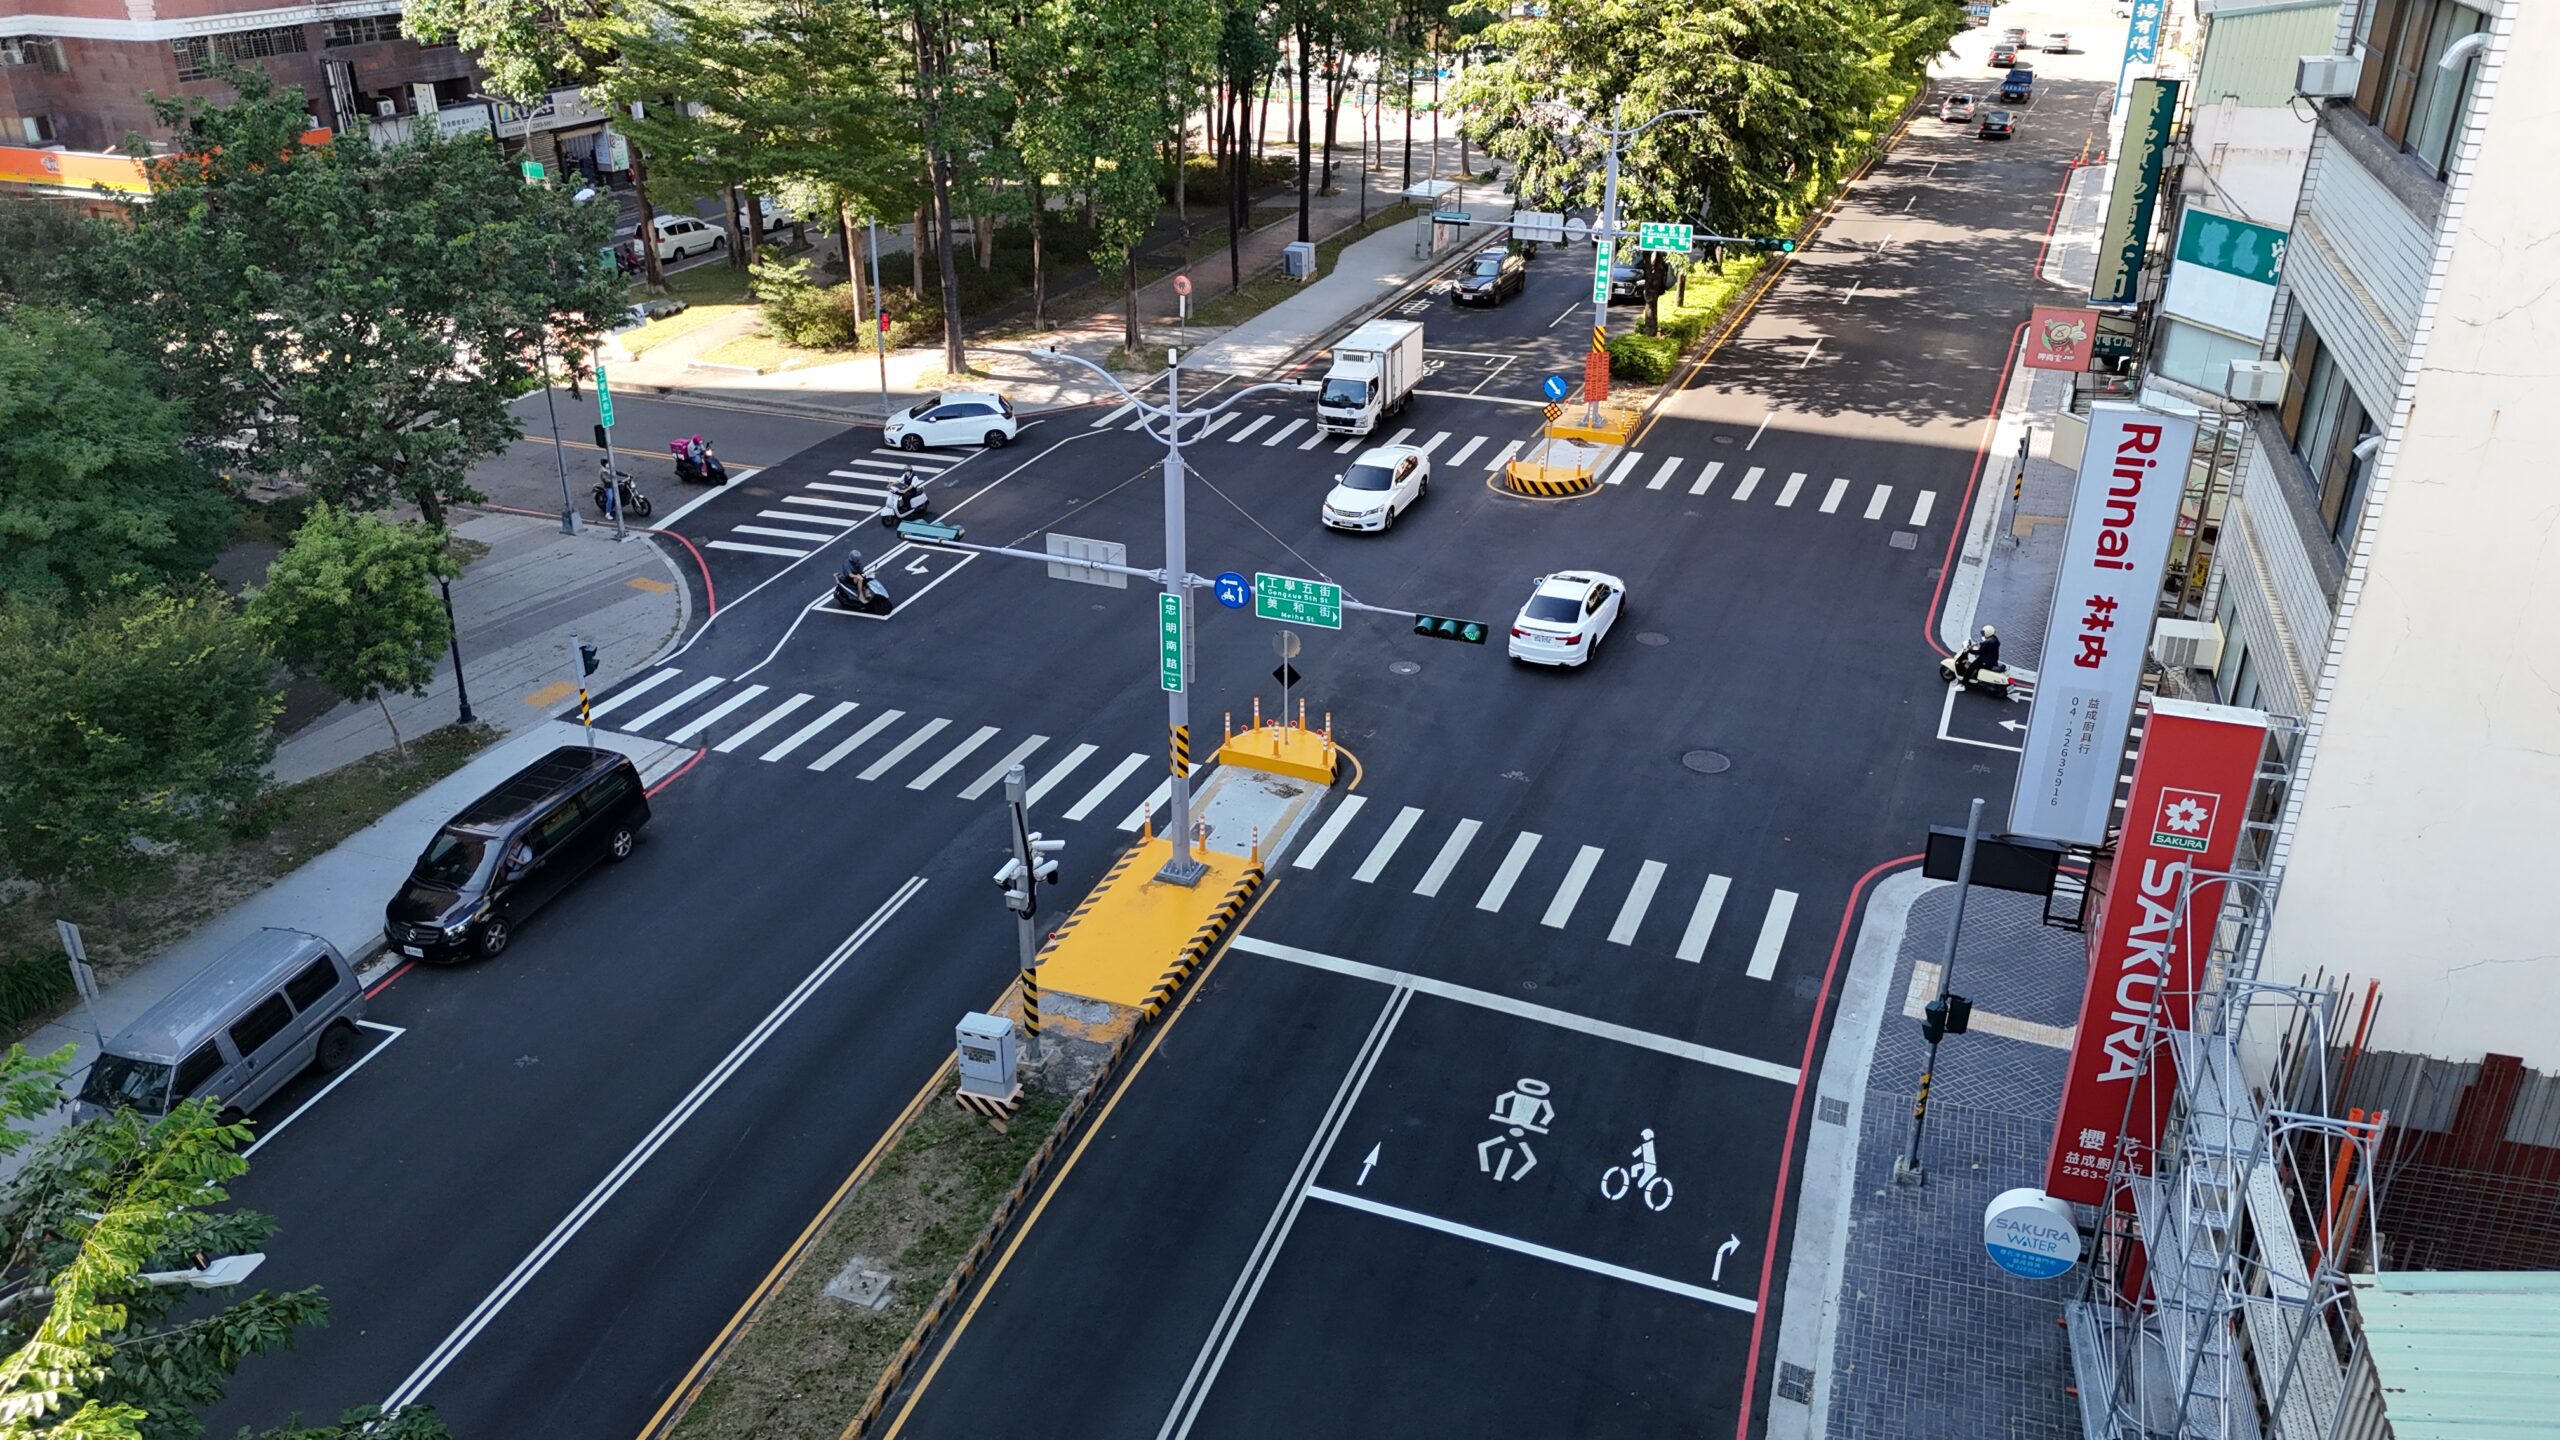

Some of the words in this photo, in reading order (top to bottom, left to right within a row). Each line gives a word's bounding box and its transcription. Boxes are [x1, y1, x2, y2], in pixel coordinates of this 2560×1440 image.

[2127, 0, 2159, 64] 揚有限公
[2094, 423, 2164, 573] Rinnai
[1267, 577, 1331, 598] 工學五街
[1267, 598, 1331, 618] 美和街
[1165, 604, 1177, 670] 忠明南路
[2155, 835, 2206, 852] SAKURA
[2097, 858, 2188, 1083] SAKURA
[1996, 1218, 2071, 1243] SAKURA
[2007, 1233, 2058, 1253] WATER
